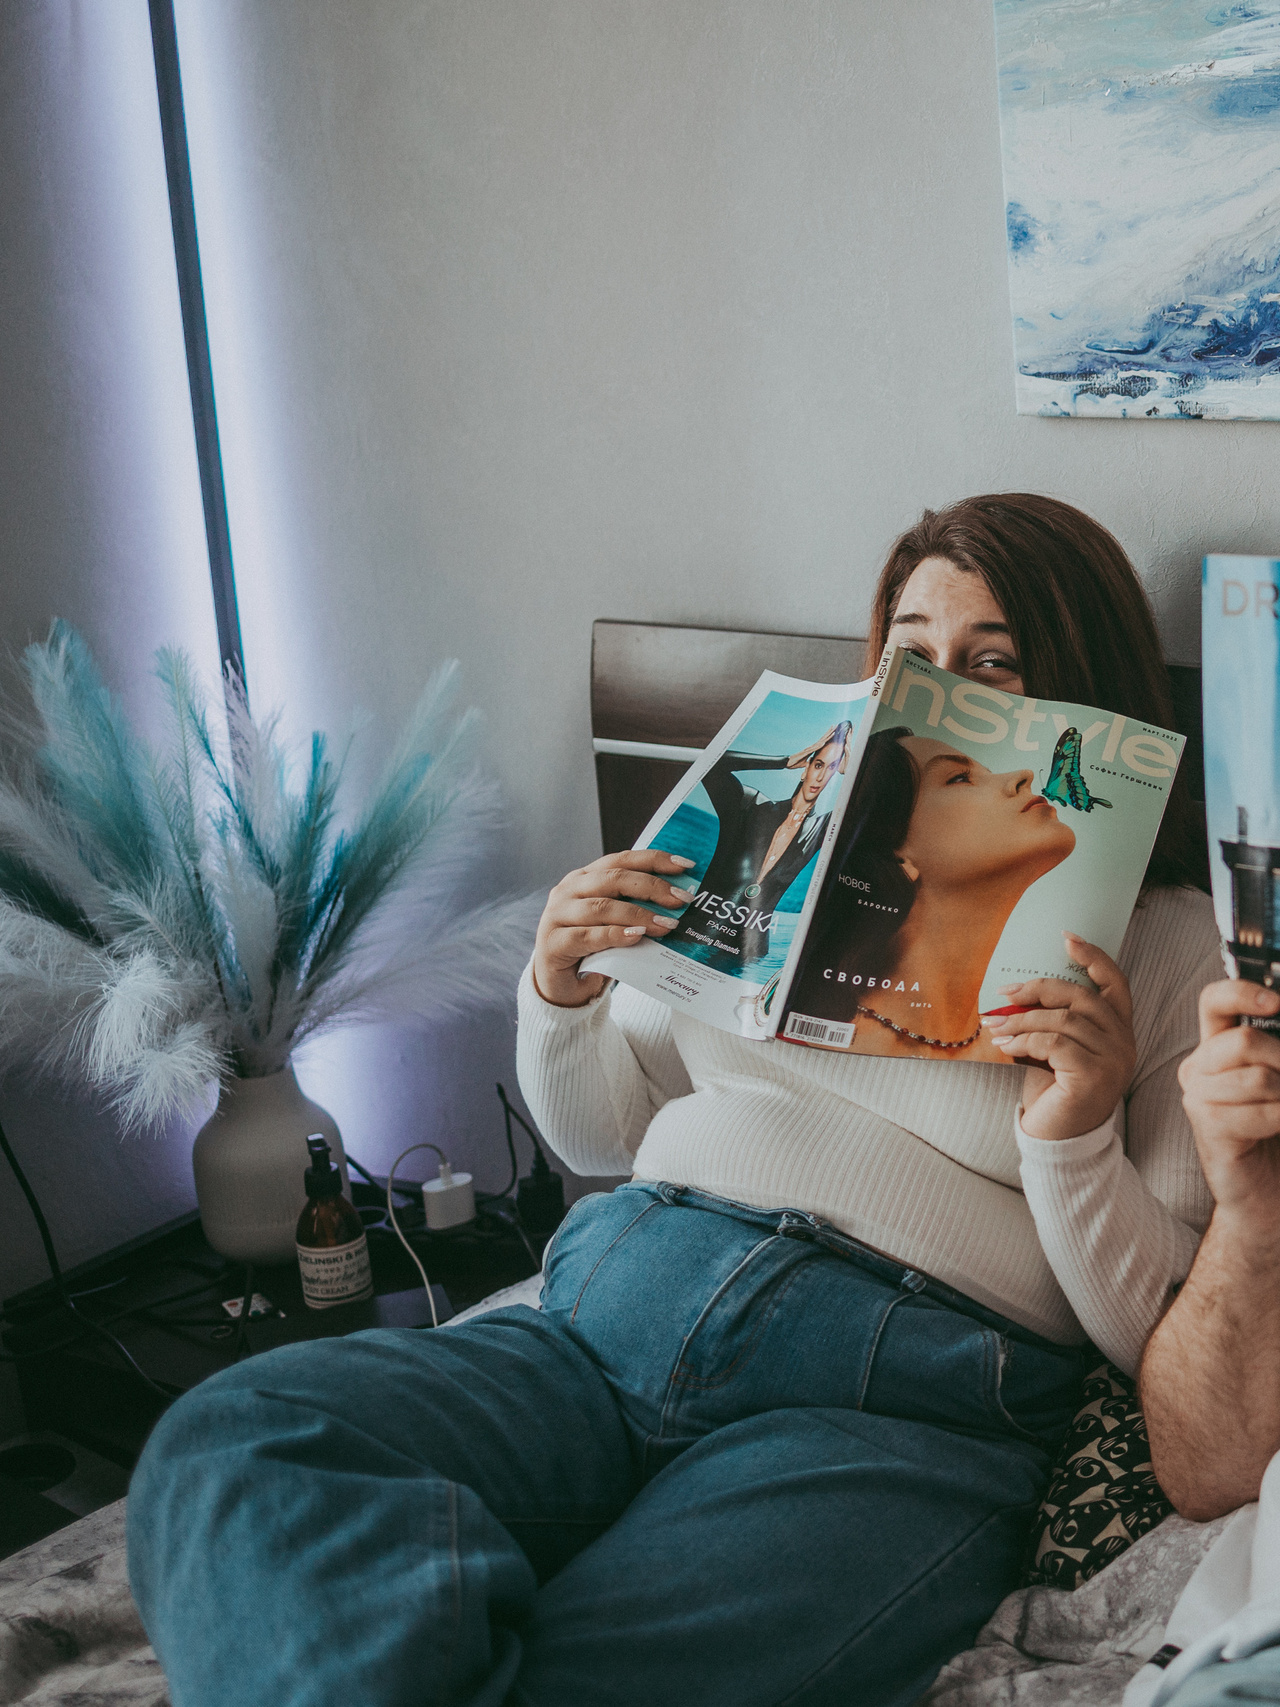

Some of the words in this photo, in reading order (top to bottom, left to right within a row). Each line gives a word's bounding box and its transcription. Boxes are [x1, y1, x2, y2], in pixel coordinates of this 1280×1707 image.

[871, 657, 891, 697] InStyle
[880, 645, 1178, 778] InStyle
[1142, 727, 1160, 736] МАРТ
[1089, 764, 1117, 776] Софья
[838, 873, 871, 893] НОВОЕ
[686, 884, 780, 935] MESSIKA
[857, 898, 899, 914] БАРОККО
[706, 920, 738, 937] PARIS
[685, 927, 714, 946] Disrupting
[713, 940, 741, 955] Diamonds
[823, 968, 920, 992] СВОБОДА
[1065, 962, 1090, 979] ЖИЗ
